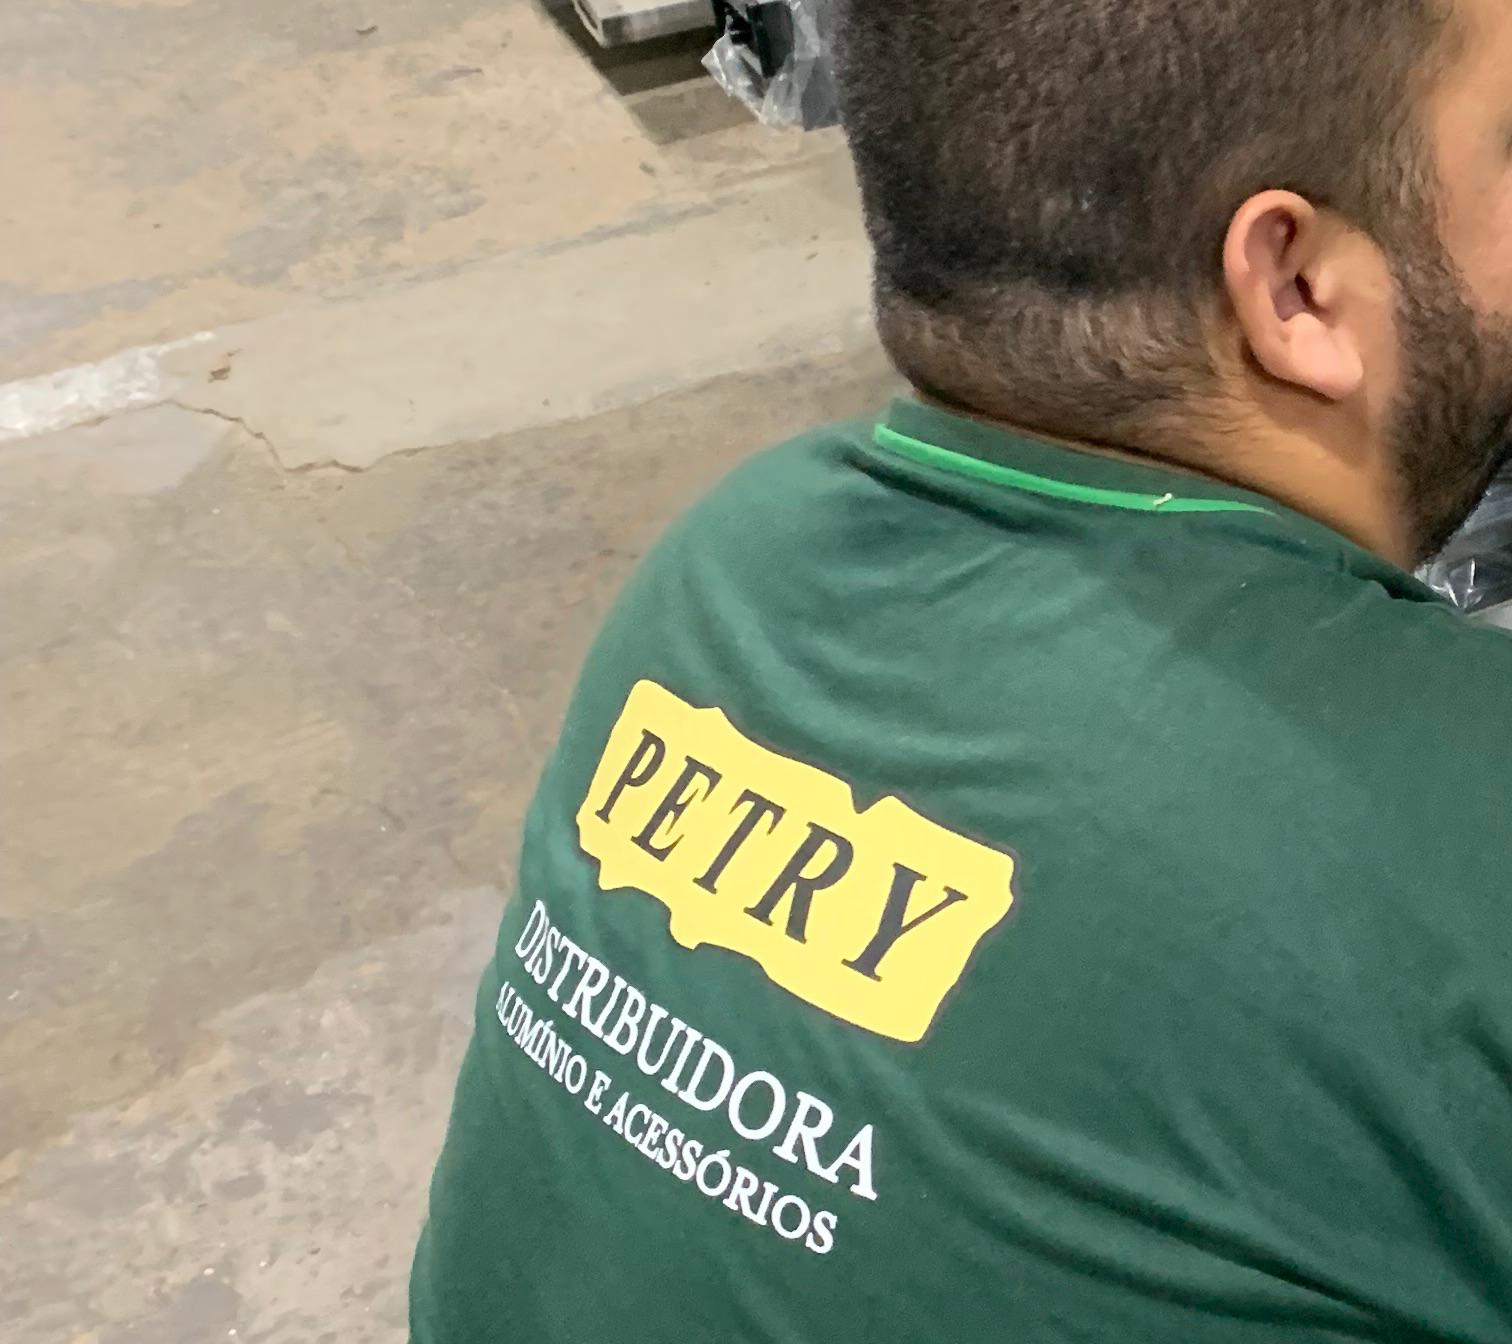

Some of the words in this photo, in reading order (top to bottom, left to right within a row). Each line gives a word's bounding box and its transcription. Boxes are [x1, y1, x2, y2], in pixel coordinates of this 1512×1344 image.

[595, 728, 968, 982] PETRY
[496, 981, 588, 1095] ALUMÍNIO
[584, 1070, 610, 1115] E
[603, 1090, 838, 1254] ACESSÓRIOS
[514, 899, 878, 1201] DISTRIBUIDORA
